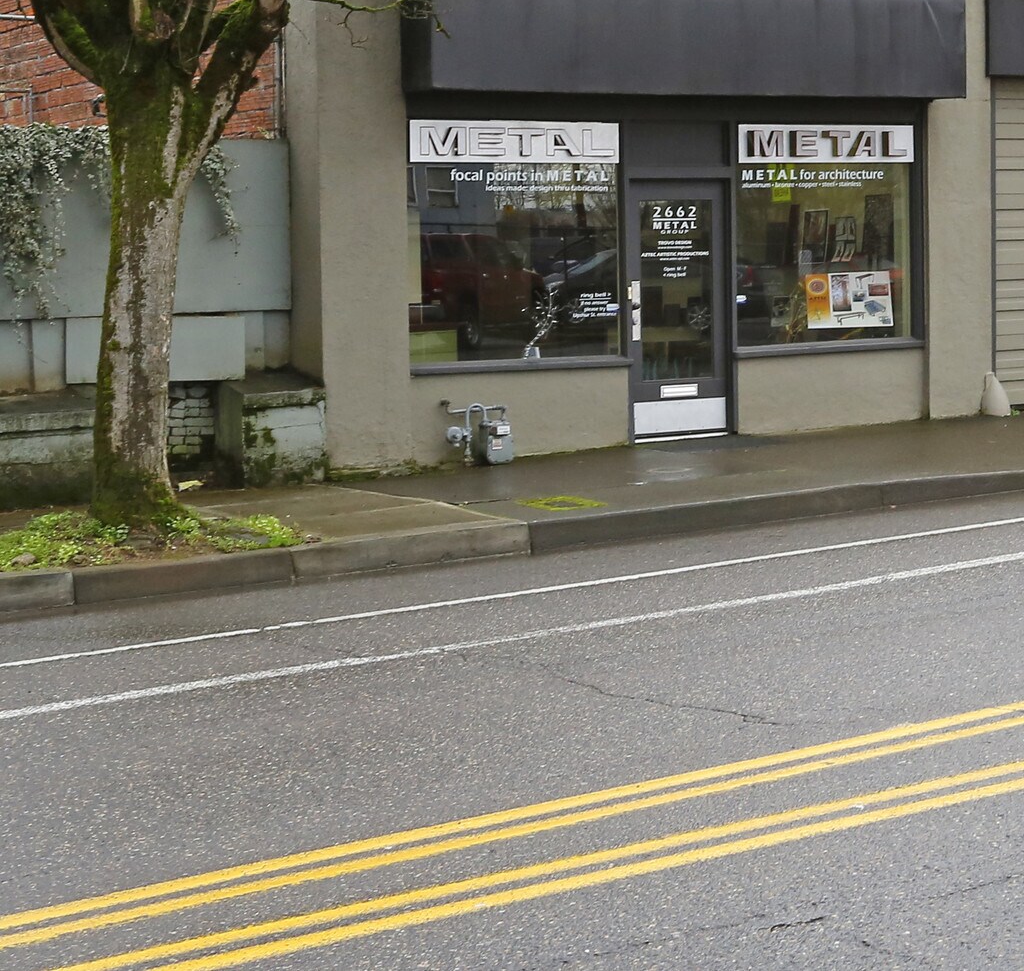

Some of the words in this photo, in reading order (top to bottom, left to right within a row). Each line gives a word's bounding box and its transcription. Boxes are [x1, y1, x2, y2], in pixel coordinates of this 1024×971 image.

[419, 126, 616, 157] METAL
[747, 130, 908, 158] METAL
[450, 168, 483, 182] focal
[486, 169, 528, 185] points
[531, 169, 543, 182] in
[546, 170, 610, 182] METAL
[741, 169, 798, 181] METAL
[800, 168, 816, 181] for
[818, 168, 884, 181] architecture
[571, 184, 609, 192] fabrication
[652, 206, 697, 218] 2662
[652, 221, 697, 230] METAL
